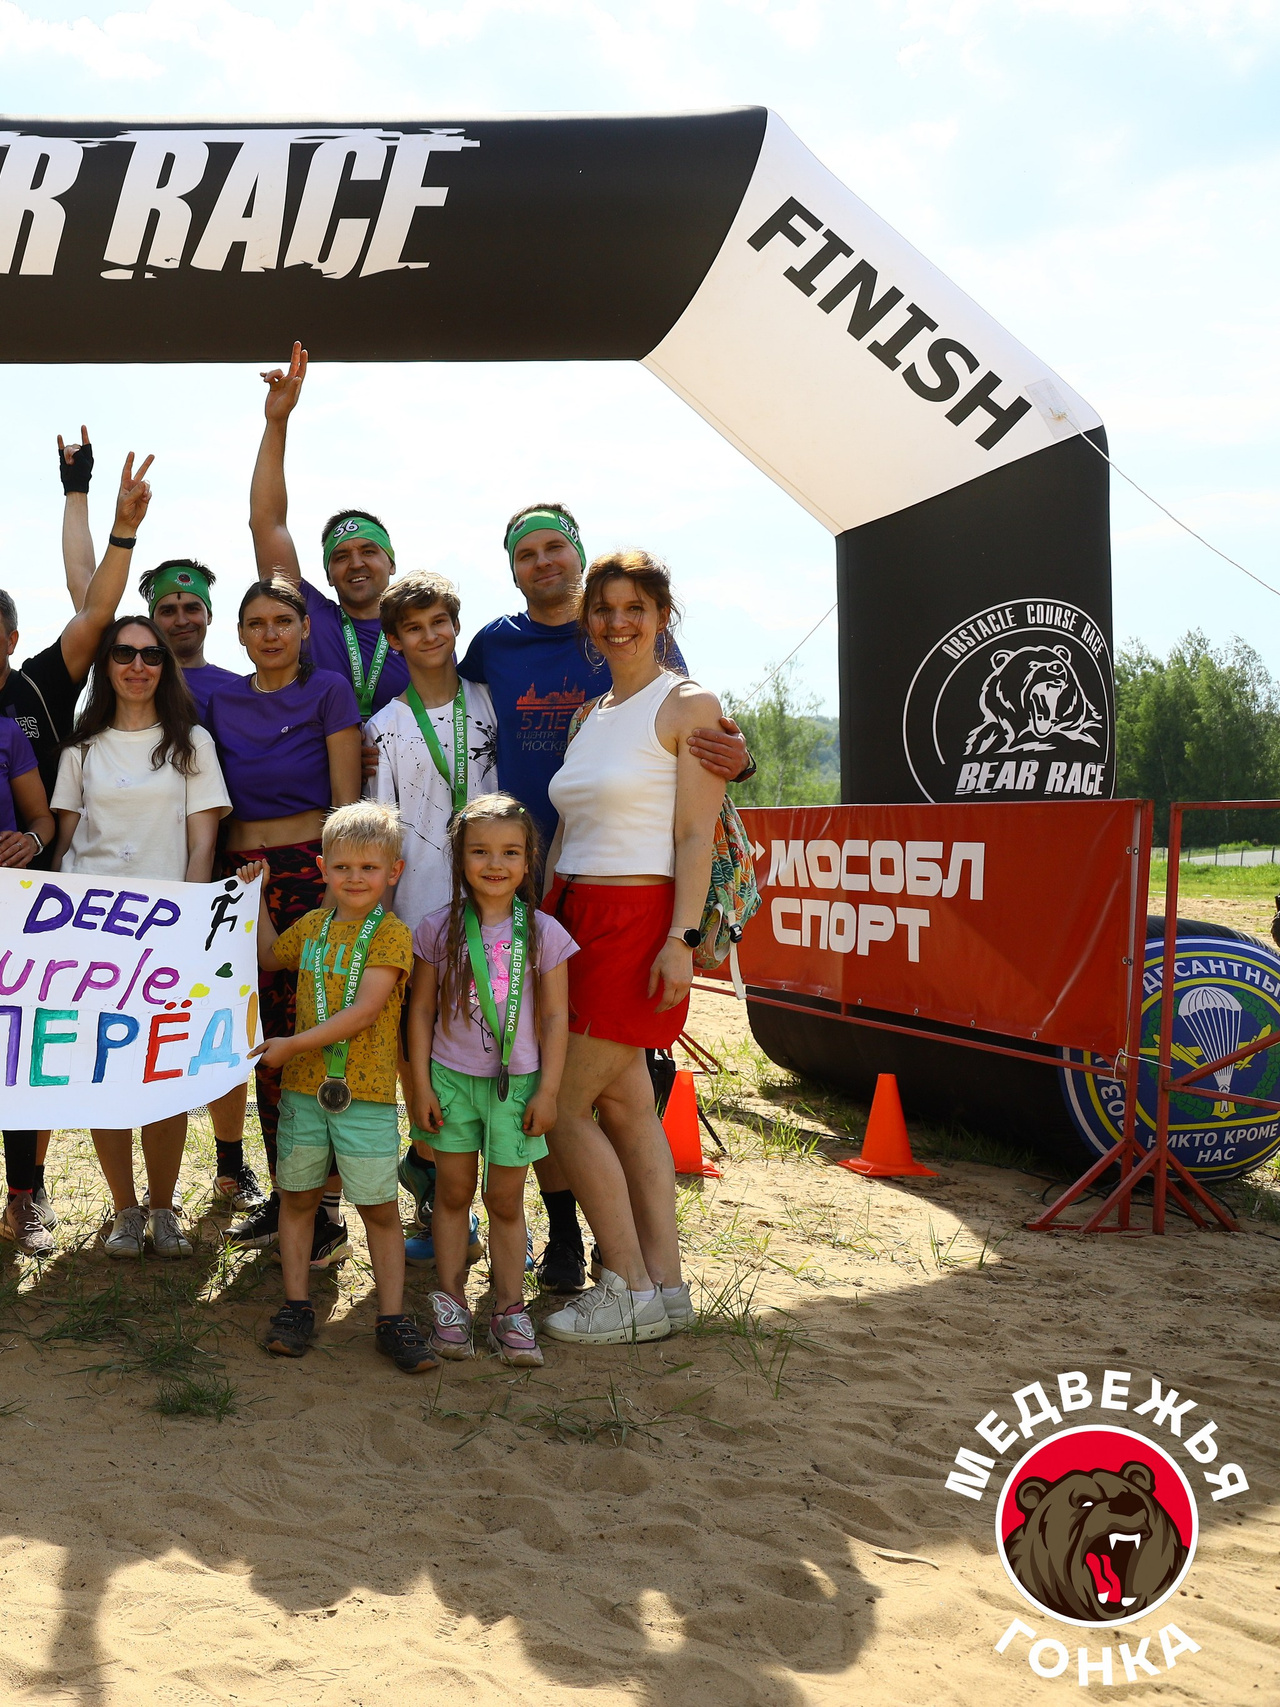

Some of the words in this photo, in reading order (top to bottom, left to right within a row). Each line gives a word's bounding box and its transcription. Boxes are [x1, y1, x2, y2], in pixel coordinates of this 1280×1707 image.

[100, 128, 480, 282] RACE
[746, 196, 1032, 451] FINISH
[333, 519, 359, 538] 36
[941, 607, 1017, 660] OBSTACLE
[1026, 603, 1079, 632] COURSE
[1081, 622, 1105, 659] RACE
[14, 716, 40, 738] ES
[455, 707, 466, 755] МЕДВЕЖЬЯ
[520, 711, 534, 730] 5
[535, 711, 572, 731] ЛЕ
[521, 740, 567, 752] МОСКВ
[457, 756, 466, 785] ГОНКА
[954, 760, 1040, 795] BEAR
[1044, 761, 1106, 796] RACE
[766, 838, 986, 901] МОСОБЛ
[22, 882, 182, 940] DEEP
[514, 907, 523, 927] 2024
[359, 919, 376, 940] 2024
[770, 897, 931, 963] СПОРТ
[314, 947, 322, 980] ГОНКА
[345, 950, 363, 1008] МЕДВЕЖЬЯ
[510, 937, 523, 996] МЕДВЕЖЬЯ
[315, 981, 327, 1025] ДВЕЖЬЯ
[507, 998, 519, 1033] ГОНКА
[1224, 1122, 1279, 1148] КРОМЕ
[1196, 1147, 1236, 1163] НАС
